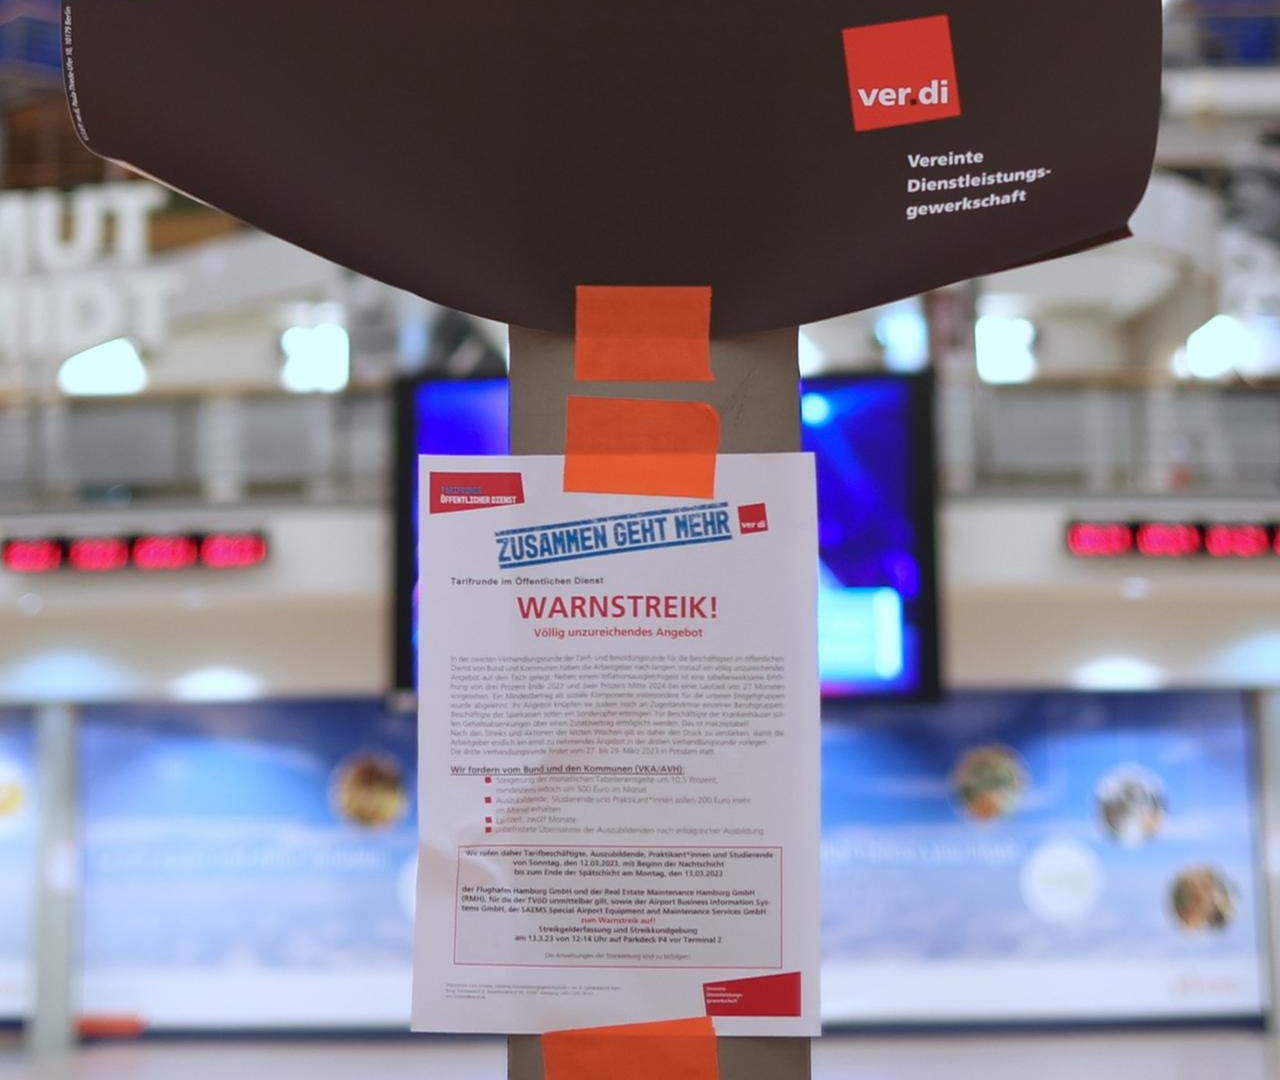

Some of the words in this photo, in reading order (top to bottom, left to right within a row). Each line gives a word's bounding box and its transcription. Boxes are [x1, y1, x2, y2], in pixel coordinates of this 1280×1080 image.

[64, 6, 72, 26] Berlin
[64, 26, 72, 45] 10179
[857, 80, 949, 107] ver.di
[907, 151, 984, 169] Vereinte
[906, 167, 1052, 193] Dienstleistungs-
[906, 189, 1027, 220] gewerkschaft
[497, 524, 608, 563] ZUSAMMEN
[615, 518, 668, 546] GEHT
[676, 510, 731, 540] MEHR
[451, 577, 498, 585] Tarifrunde
[501, 577, 512, 585] im
[515, 576, 571, 585] Öffentlichen
[575, 576, 604, 584] Dienst
[517, 596, 717, 619] WARNSTREIK!
[534, 627, 565, 639] Völlig
[568, 626, 653, 637] unzureichendes
[656, 626, 703, 639] Angebot
